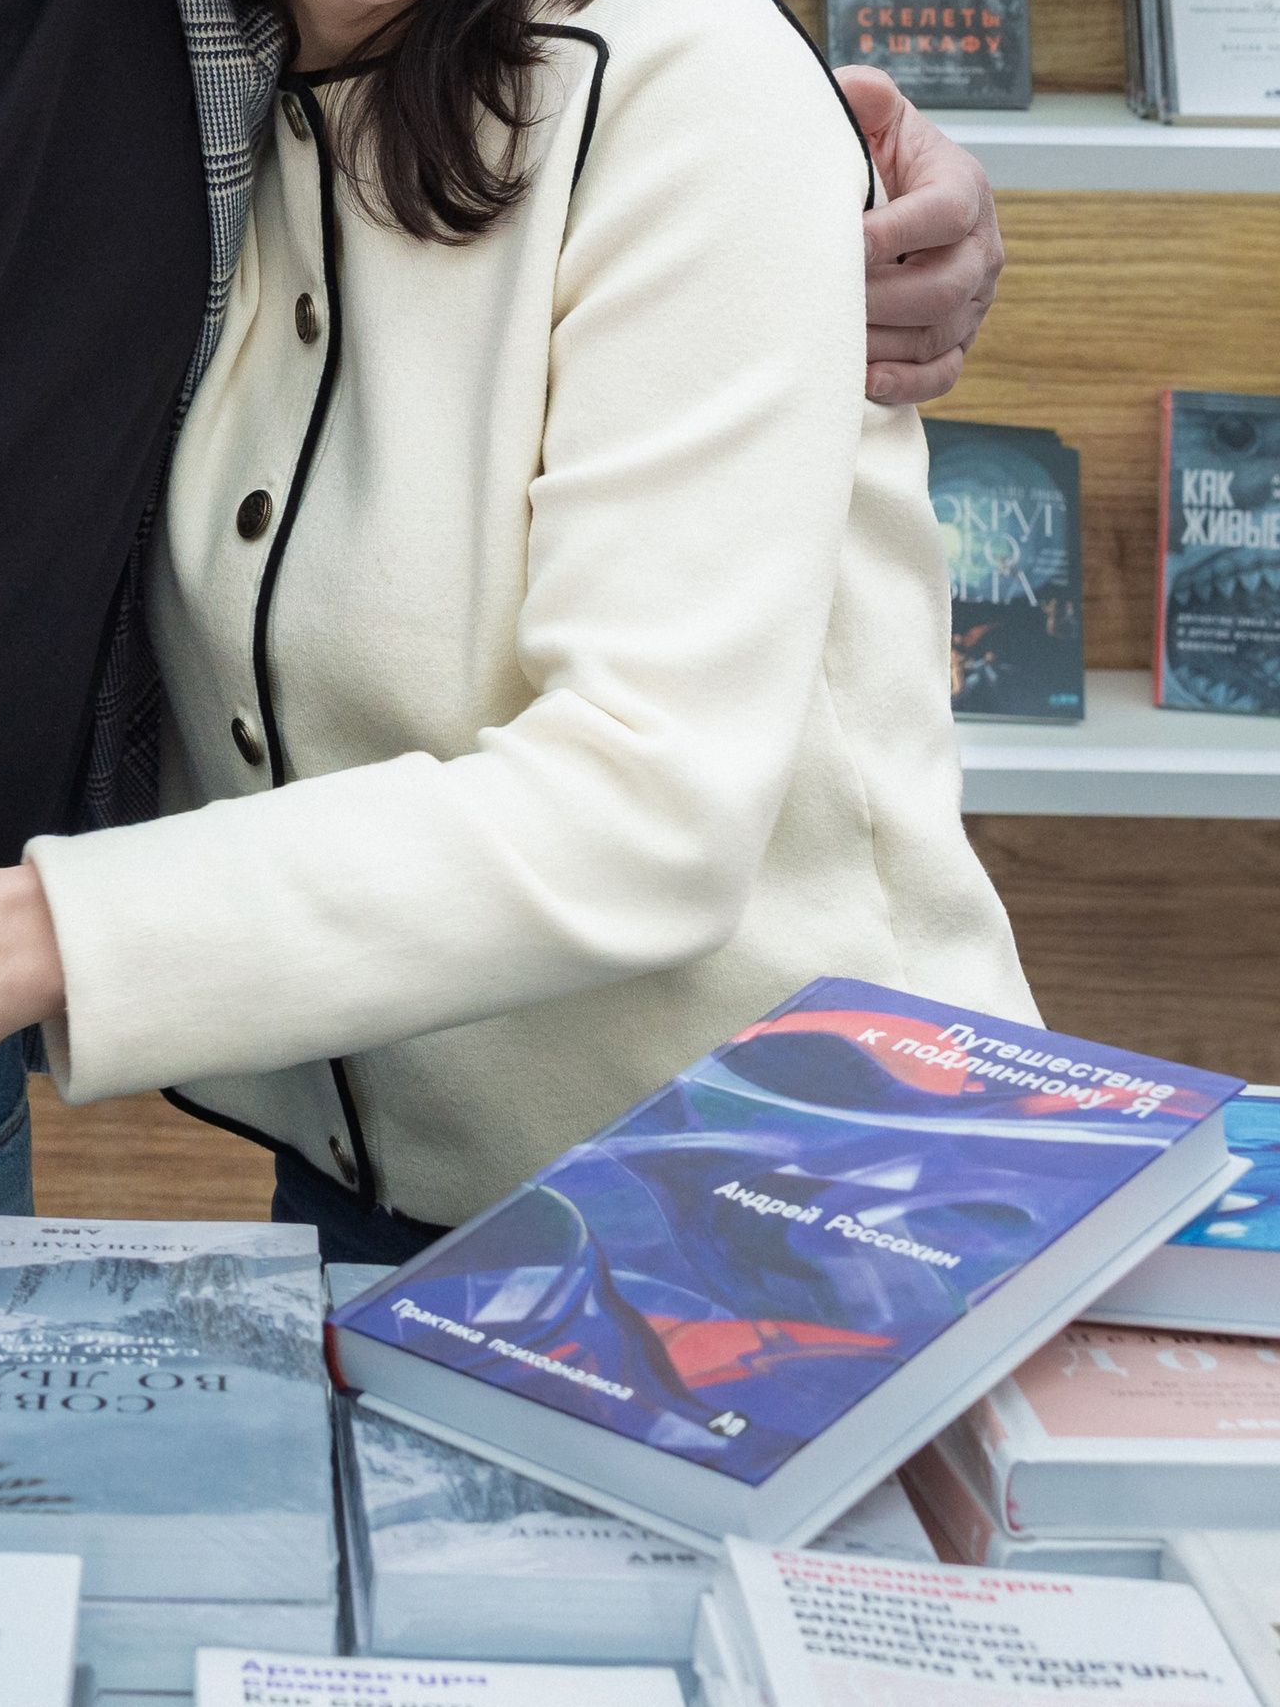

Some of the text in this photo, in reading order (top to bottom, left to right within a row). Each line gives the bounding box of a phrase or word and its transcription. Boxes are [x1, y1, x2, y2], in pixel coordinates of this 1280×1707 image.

[857, 6, 1002, 29] СКЕЛЕТЫ
[859, 32, 1002, 55] В ШКАФУ
[1182, 468, 1235, 509] КАК
[928, 493, 1067, 543] ОКРУГ
[1181, 507, 1280, 551] ЖИВЫЕ
[856, 1027, 1162, 1120] к подлинному Я
[936, 1023, 1176, 1101] Путешествие
[712, 1180, 962, 1270] Андрей Россохин
[101, 1356, 159, 1368] КАК
[391, 1297, 634, 1401] Практика психоанализа
[138, 1372, 229, 1393] ВО
[783, 1578, 952, 1613] Секреты
